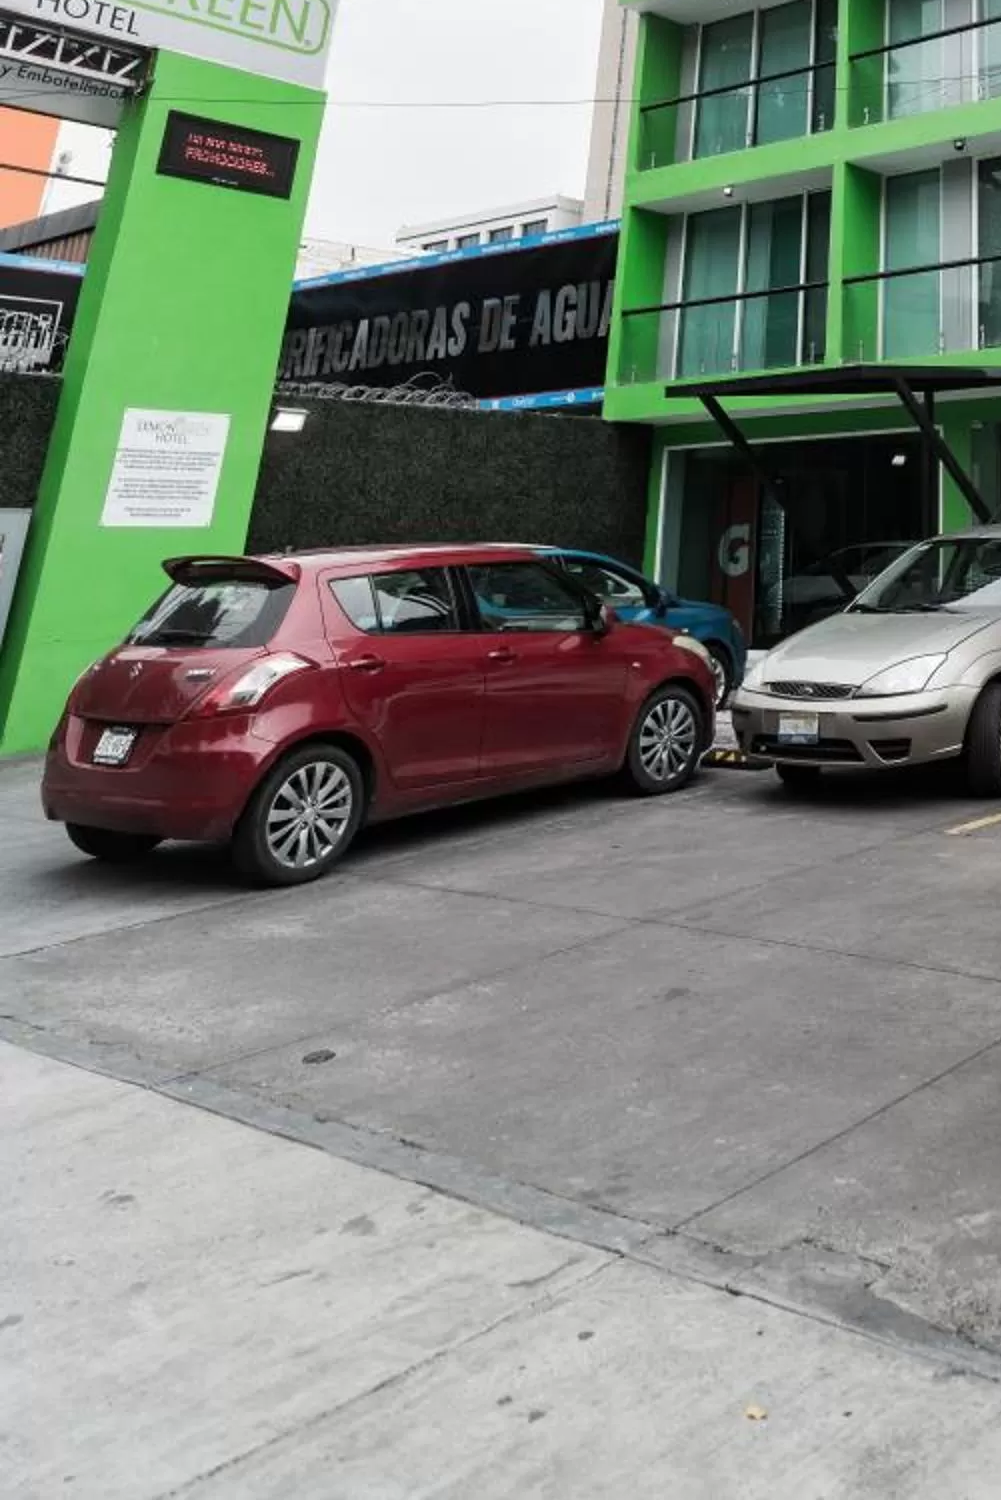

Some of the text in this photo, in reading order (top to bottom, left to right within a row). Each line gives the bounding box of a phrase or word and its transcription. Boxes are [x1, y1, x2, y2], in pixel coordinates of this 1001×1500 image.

[17, 65, 123, 100] Embotellado
[280, 301, 470, 379] RIFICADORAS
[477, 294, 521, 352] DE
[719, 523, 749, 577] G
